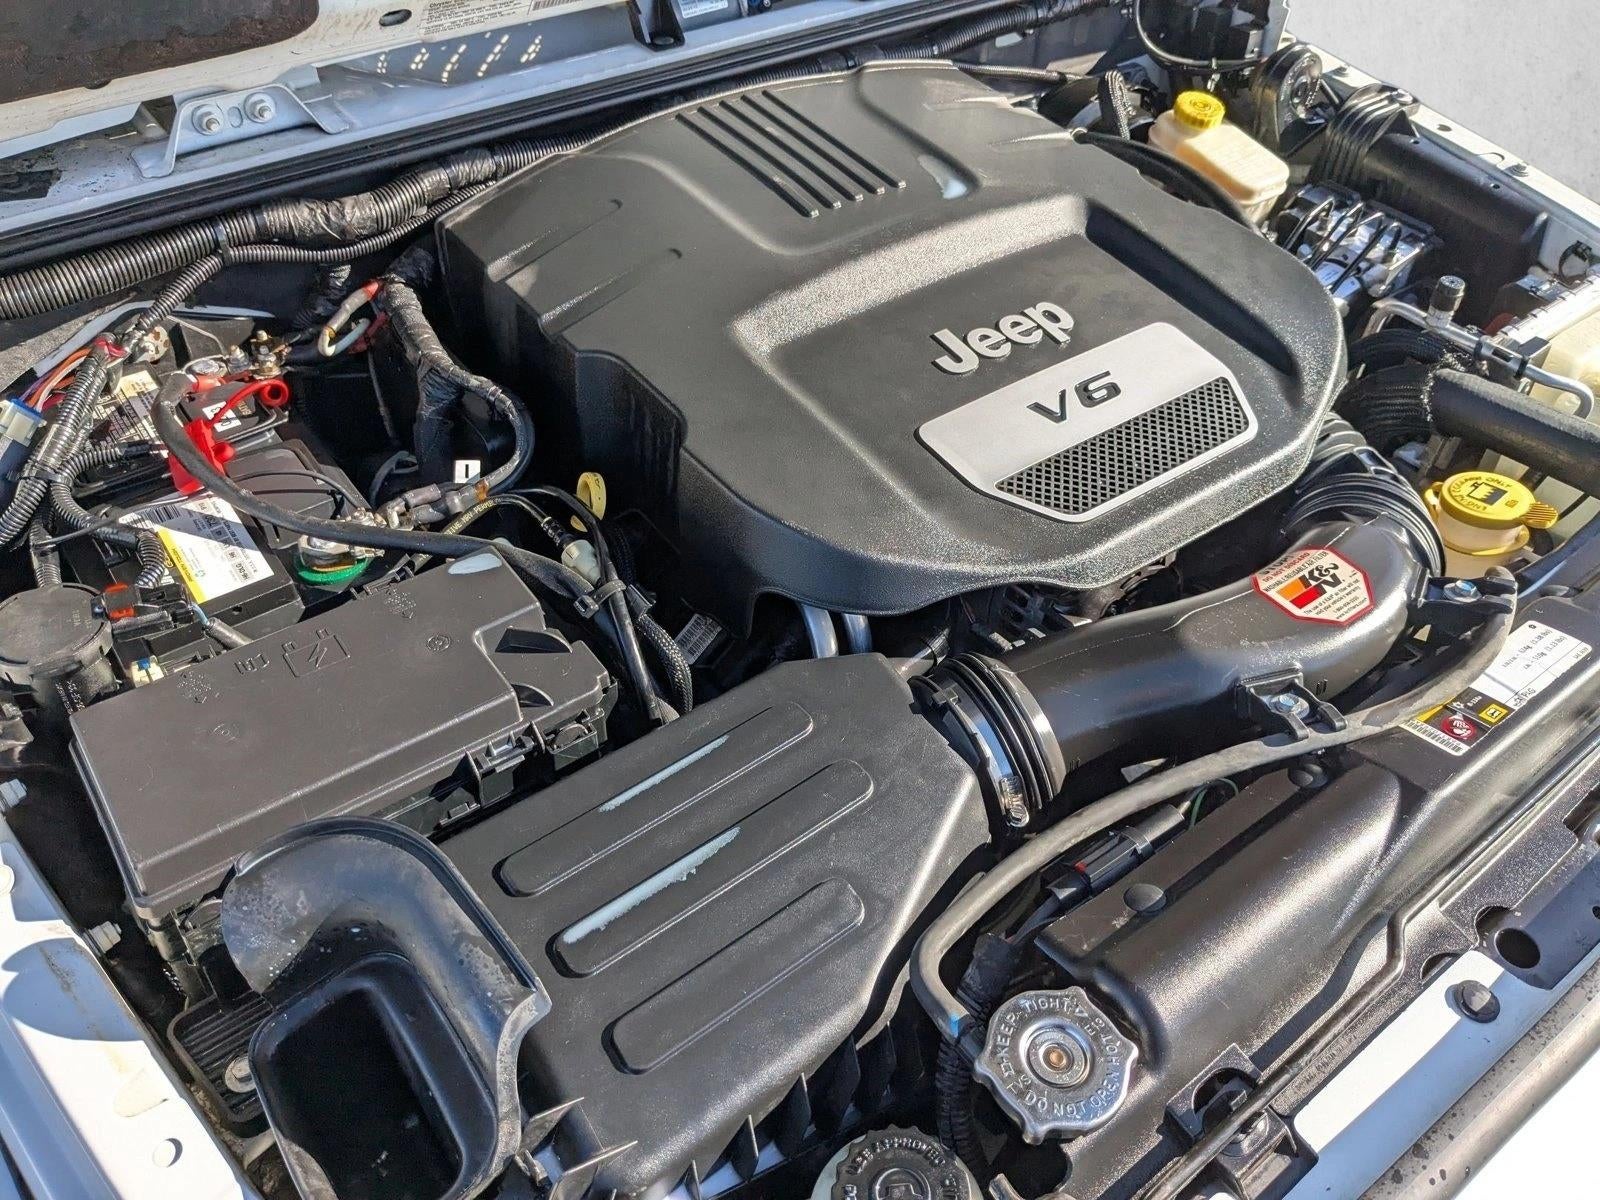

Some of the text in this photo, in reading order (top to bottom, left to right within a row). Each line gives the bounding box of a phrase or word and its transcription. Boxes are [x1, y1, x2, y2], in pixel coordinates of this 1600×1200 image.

[929, 301, 1074, 374] Jeep
[1026, 371, 1122, 424] V6
[1272, 567, 1283, 576] NOT
[1298, 563, 1342, 595] K&N
[995, 1012, 1020, 1058] KEEP
[1021, 997, 1071, 1014] TIGHT
[1100, 1033, 1120, 1065] HOT
[1025, 1092, 1048, 1111] DO
[1091, 1071, 1120, 1107] OPEN
[1054, 1100, 1087, 1117] NOT
[874, 1136, 946, 1167] APPROVED
